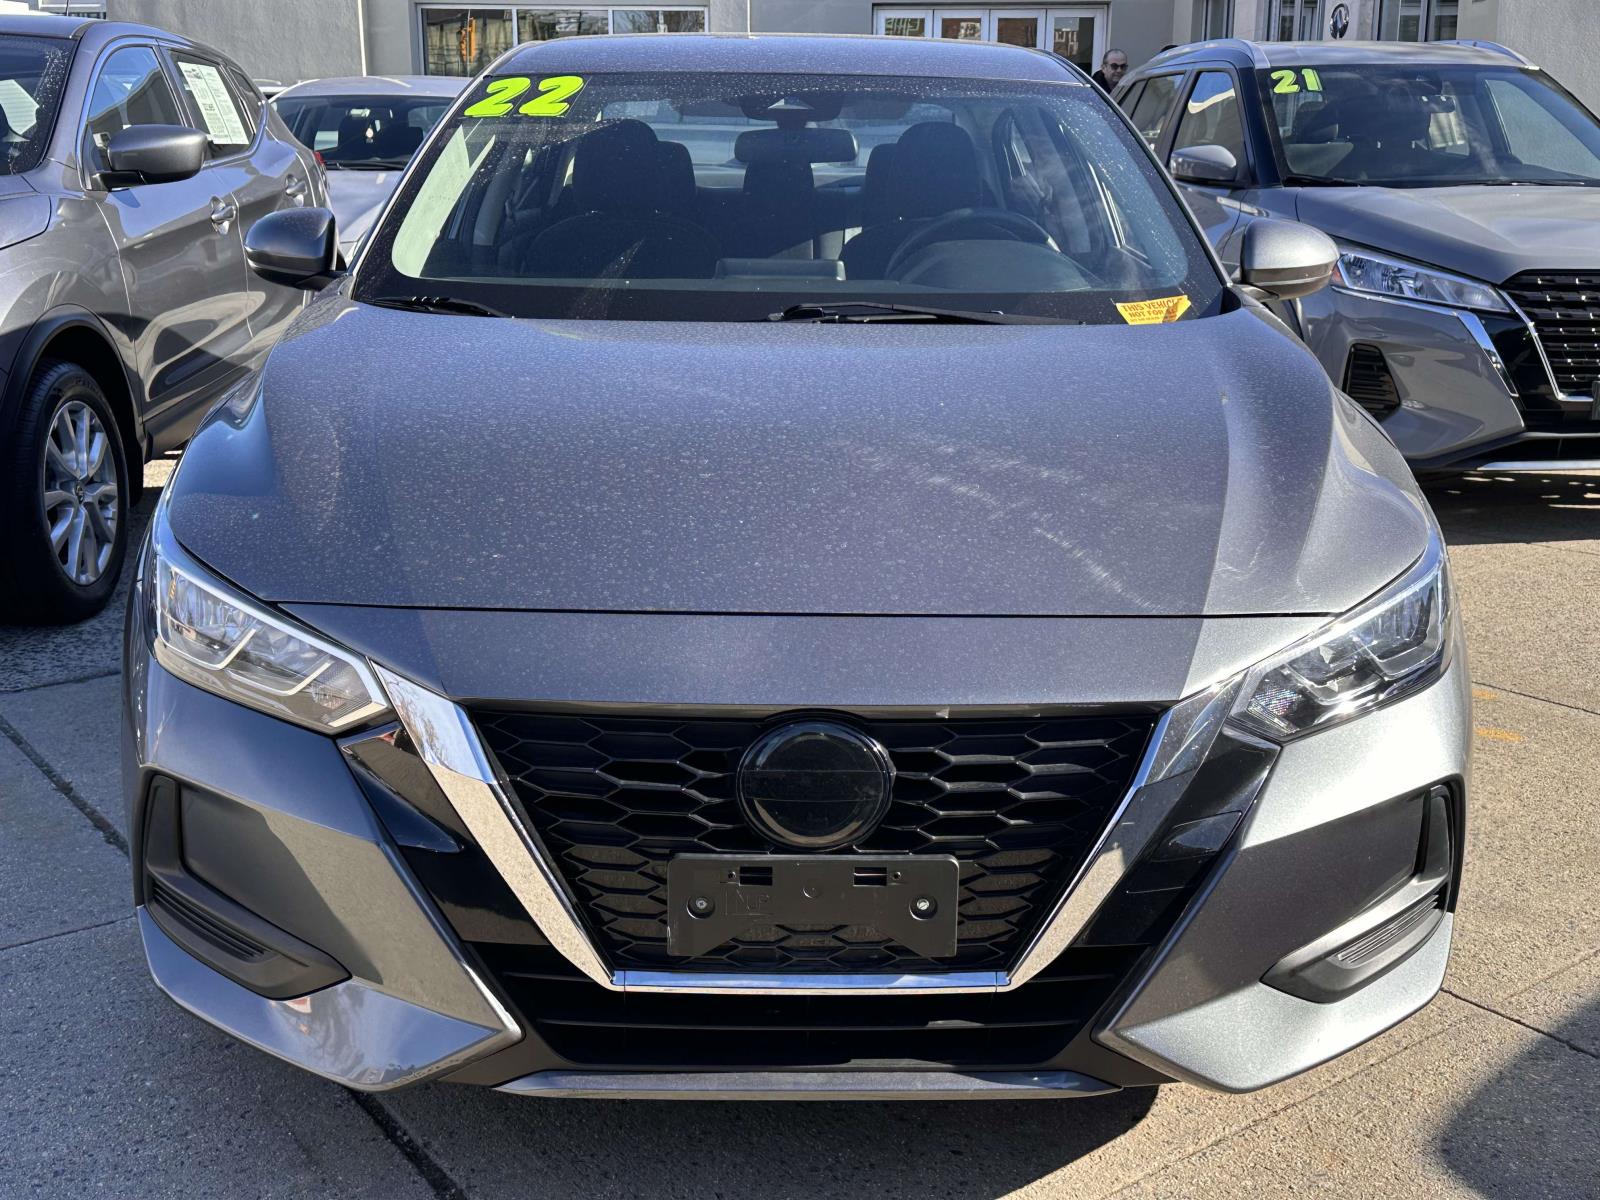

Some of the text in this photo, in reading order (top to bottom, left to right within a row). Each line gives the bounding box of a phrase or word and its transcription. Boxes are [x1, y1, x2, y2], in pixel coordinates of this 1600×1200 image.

[1270, 68, 1323, 94] 21
[464, 75, 584, 118] 22
[1122, 299, 1179, 313] THIS VEHICL
